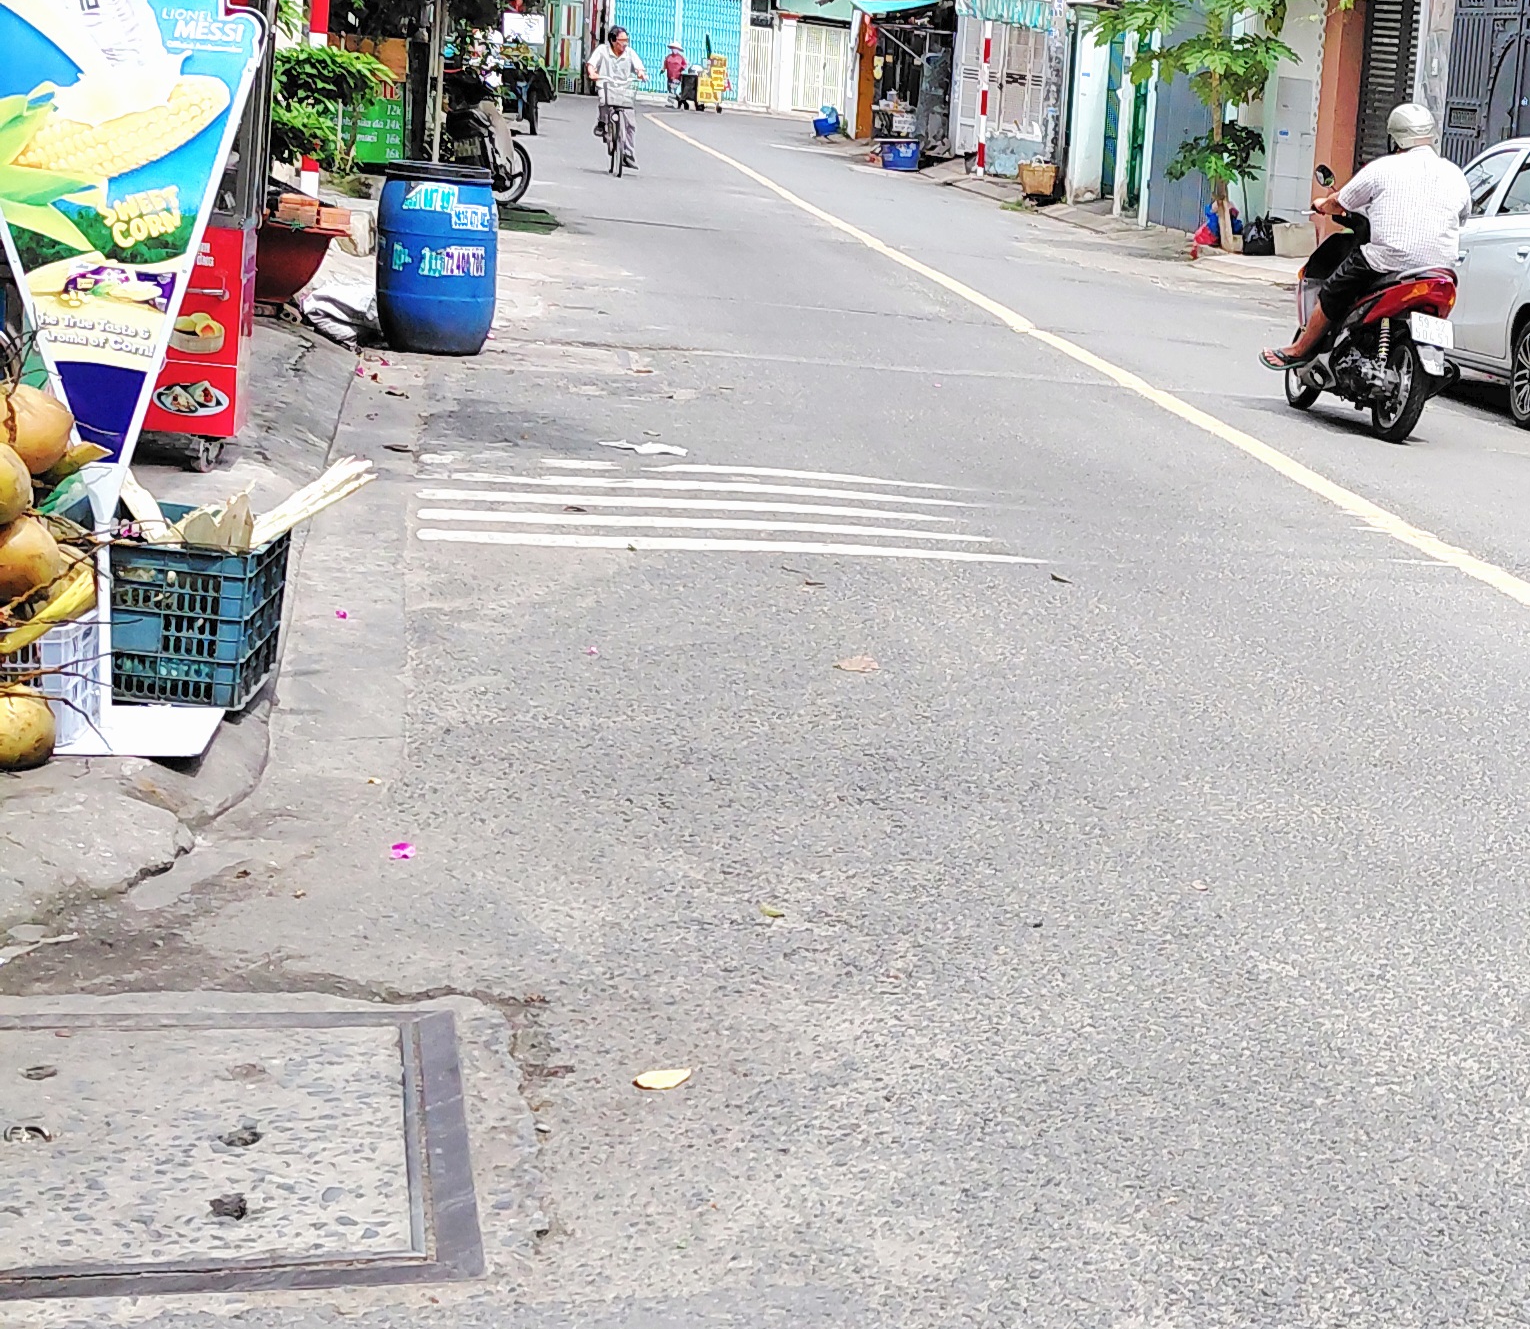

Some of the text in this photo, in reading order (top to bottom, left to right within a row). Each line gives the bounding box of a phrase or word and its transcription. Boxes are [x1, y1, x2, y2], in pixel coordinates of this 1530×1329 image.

[161, 7, 213, 22] LIONEL
[174, 20, 245, 43] MESSI
[97, 185, 180, 227] SWEET
[112, 210, 181, 248] CORN
[61, 315, 95, 330] True
[97, 320, 138, 338] Taste
[89, 337, 108, 350] of
[108, 336, 157, 358] Corn!
